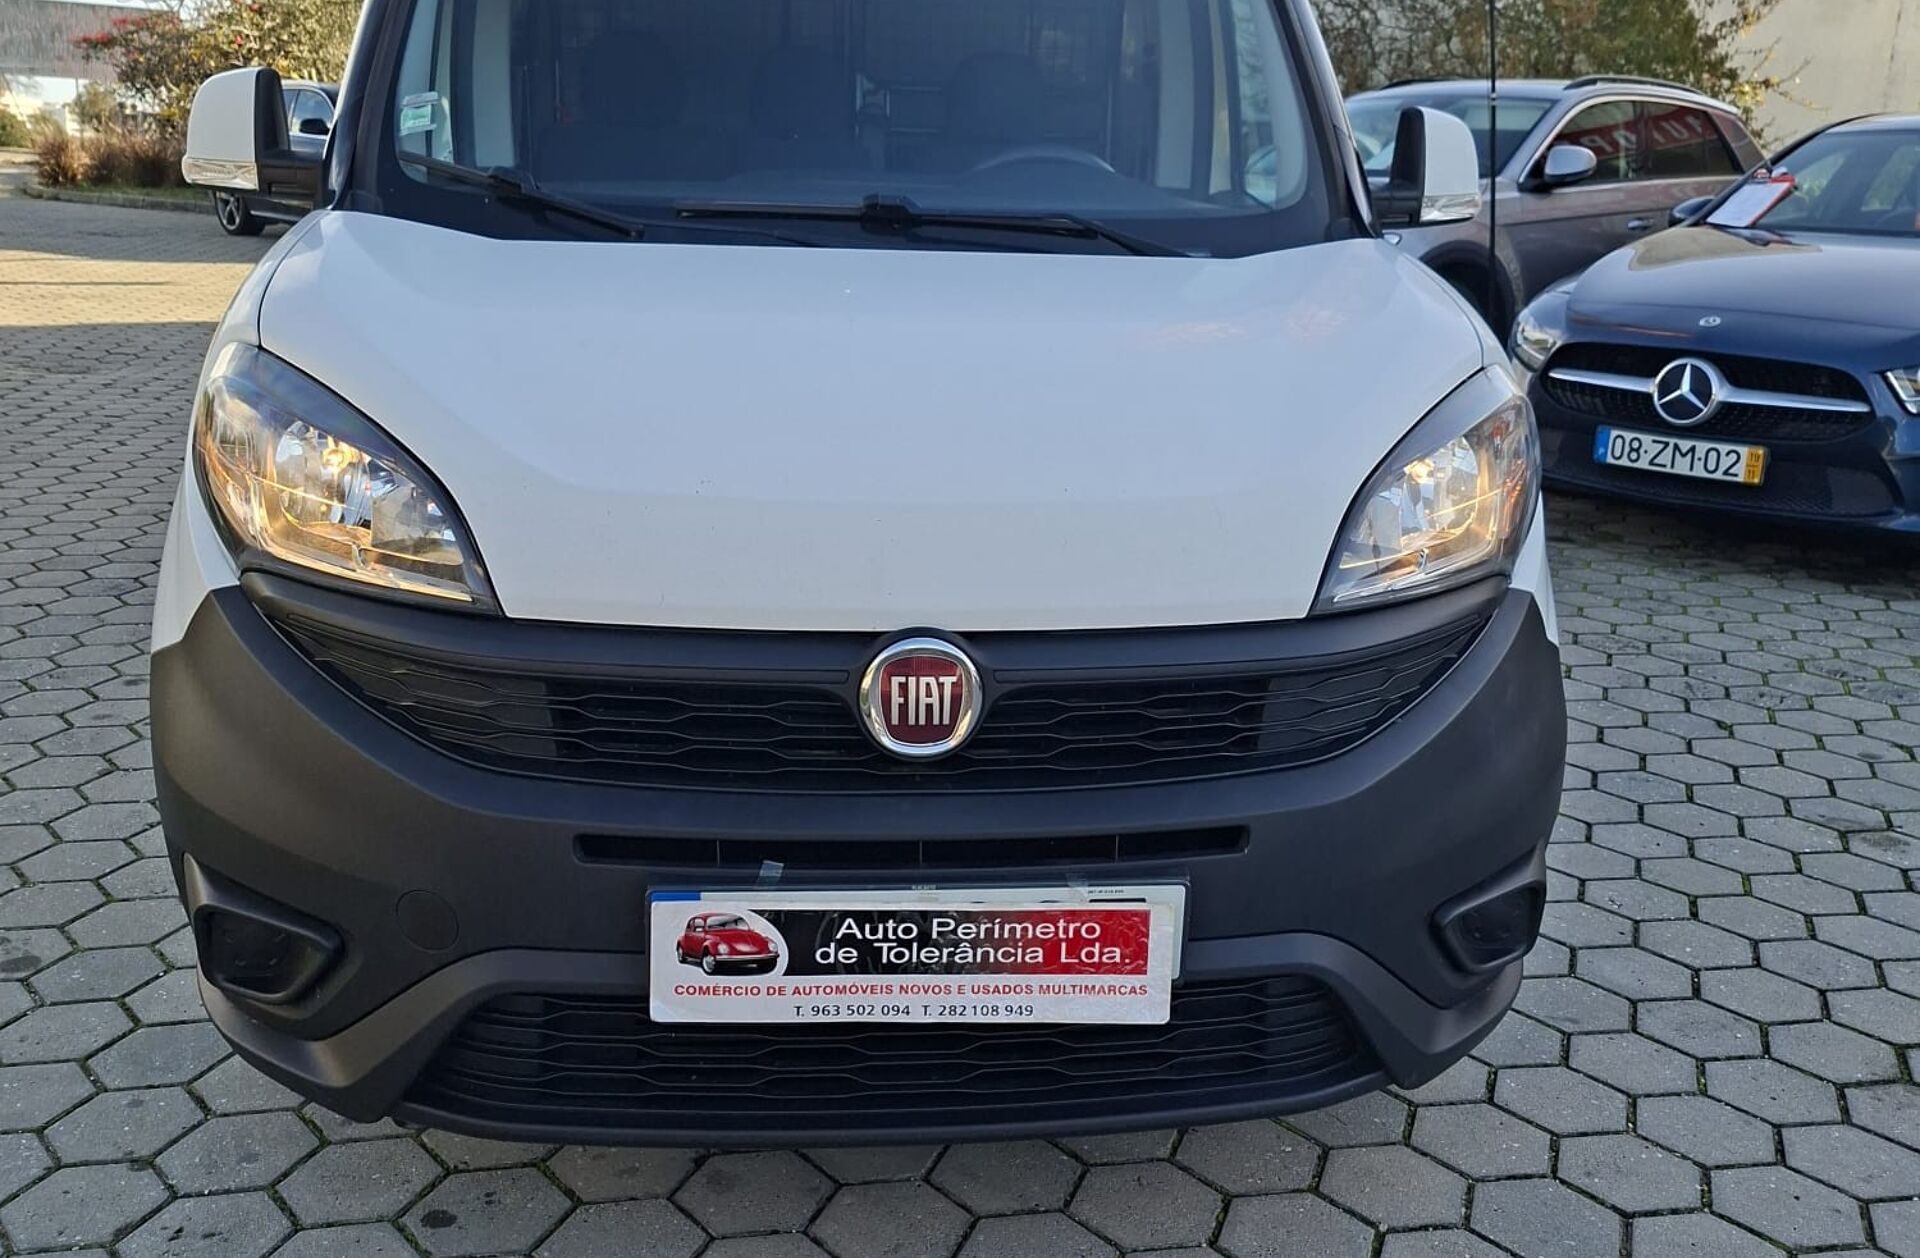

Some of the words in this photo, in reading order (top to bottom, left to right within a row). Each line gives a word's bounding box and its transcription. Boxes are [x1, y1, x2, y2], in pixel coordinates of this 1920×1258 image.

[890, 676, 958, 725] FIAT
[835, 917, 918, 939] Auto
[931, 917, 1101, 939] Perímetro
[815, 942, 858, 964] de
[873, 942, 1043, 964] Tolerância
[1060, 941, 1130, 964] Lda.
[673, 983, 761, 997] COMÉRCIO
[766, 984, 786, 996] DE
[791, 983, 893, 996] AUTOMÓVEIS
[899, 983, 952, 996] NOVOS
[957, 984, 966, 996] E
[971, 984, 1034, 996] USADOS
[1038, 984, 1148, 996] MULTIMARCAS
[793, 1005, 805, 1017] T.
[811, 1004, 841, 1017] 963
[846, 1004, 876, 1017] 502
[881, 1004, 911, 1017] 094
[921, 1004, 932, 1017] T.
[938, 1004, 967, 1017] 282
[972, 1004, 1000, 1017] 108
[1004, 1003, 1034, 1017] 949
